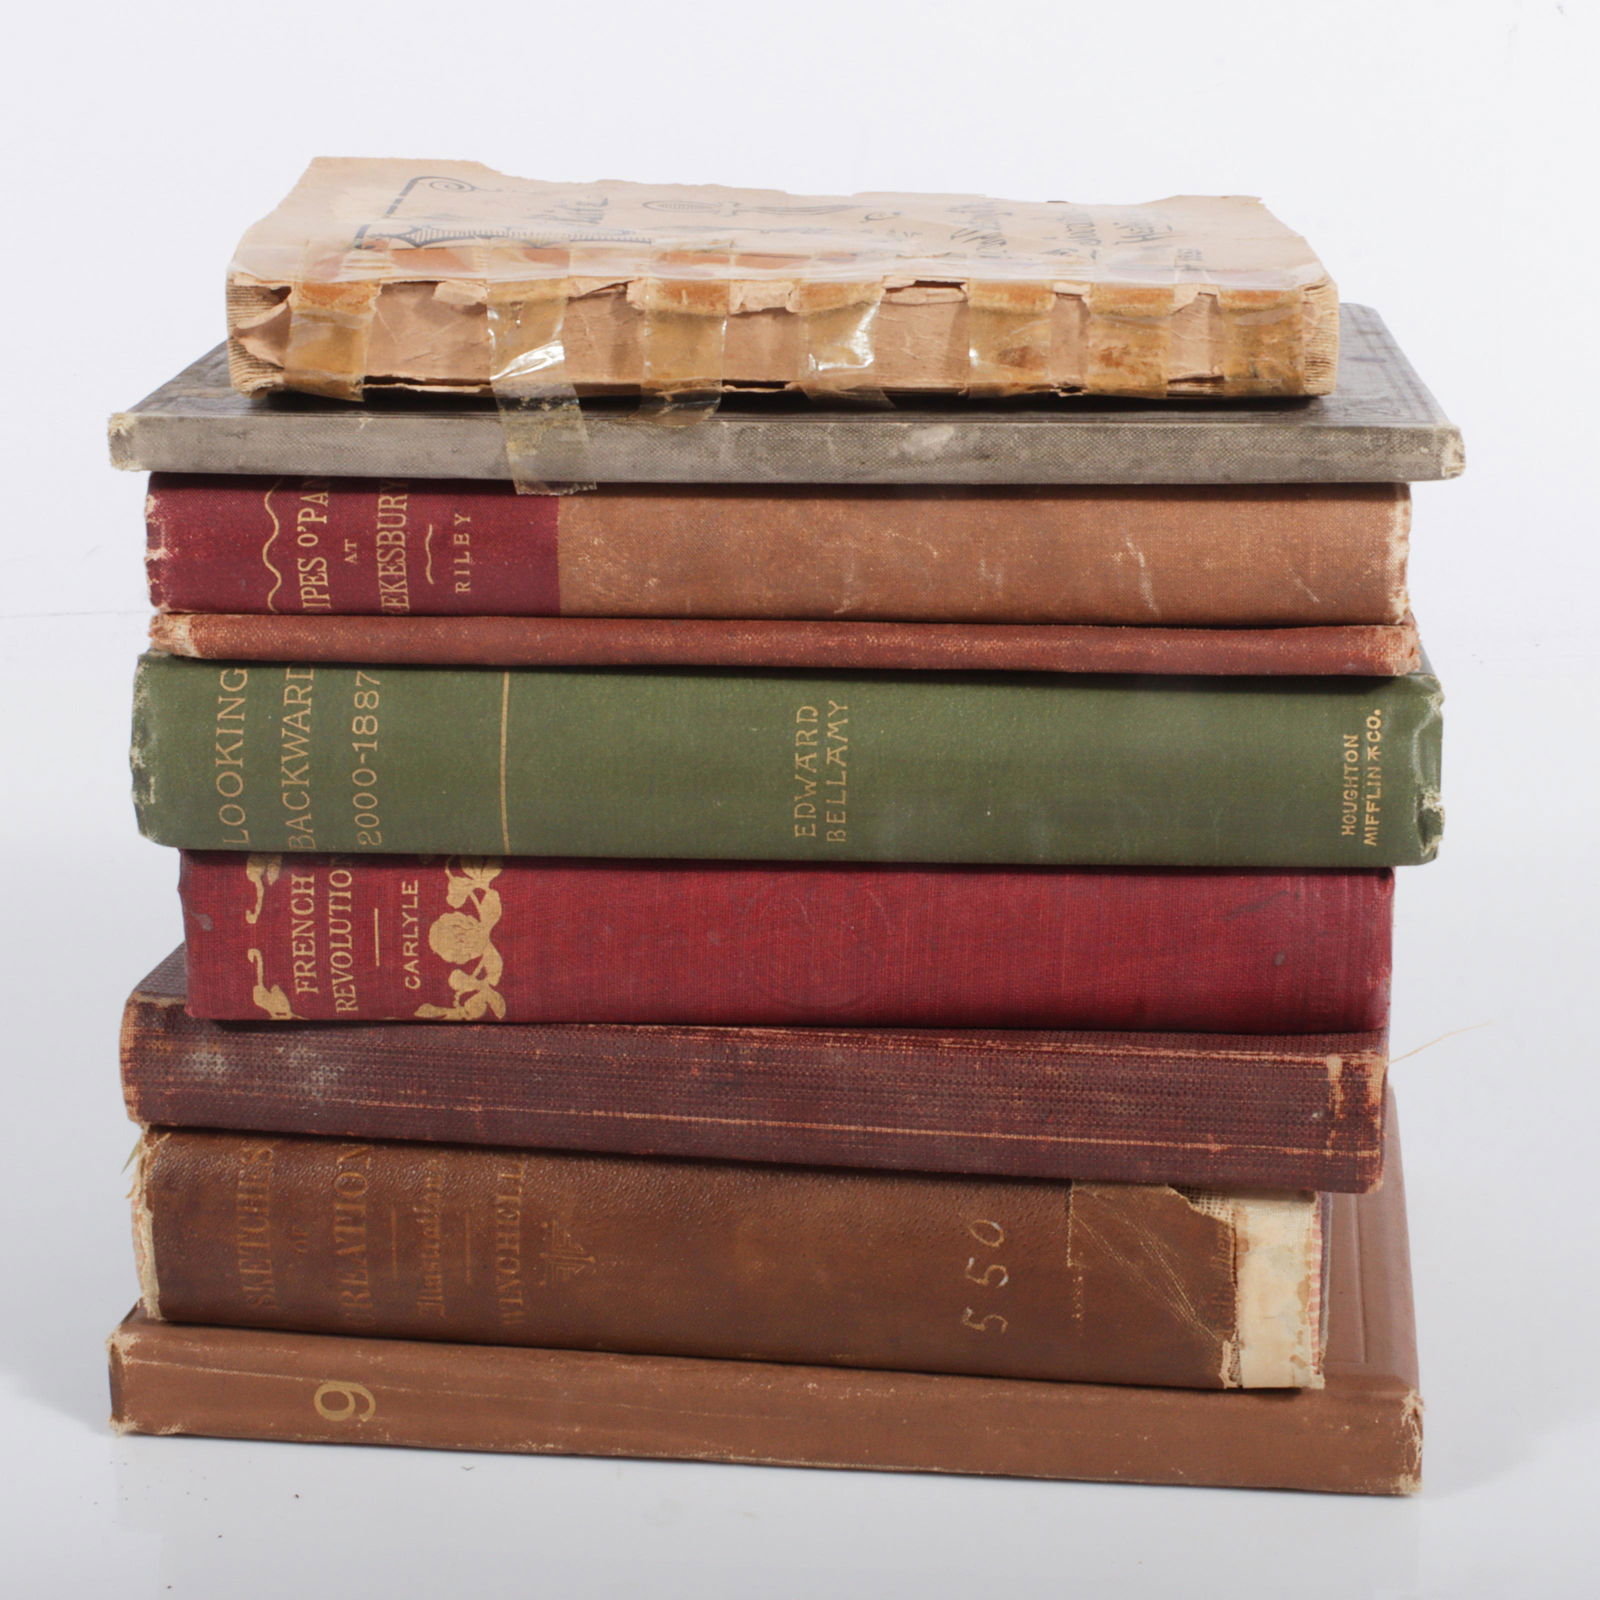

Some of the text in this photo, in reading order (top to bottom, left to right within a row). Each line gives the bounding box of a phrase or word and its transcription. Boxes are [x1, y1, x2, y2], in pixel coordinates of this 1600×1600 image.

[297, 556, 332, 610] IPES
[344, 539, 357, 564] AT
[454, 513, 471, 594] RILEY
[215, 667, 249, 845] LOOKING
[351, 670, 383, 846] 2000-1887
[794, 706, 818, 838] EDWARD
[826, 700, 849, 842] BELLAMY
[1366, 709, 1382, 742] CO.
[1341, 733, 1360, 836] HOUGHTON
[1363, 766, 1382, 847] MIFFLIN
[291, 872, 319, 995] FRENCH
[329, 868, 359, 1014] REVOLUTIO
[402, 879, 421, 990] CARLYLE
[237, 1145, 278, 1311] SKETCHES
[960, 1219, 1009, 1334] 550
